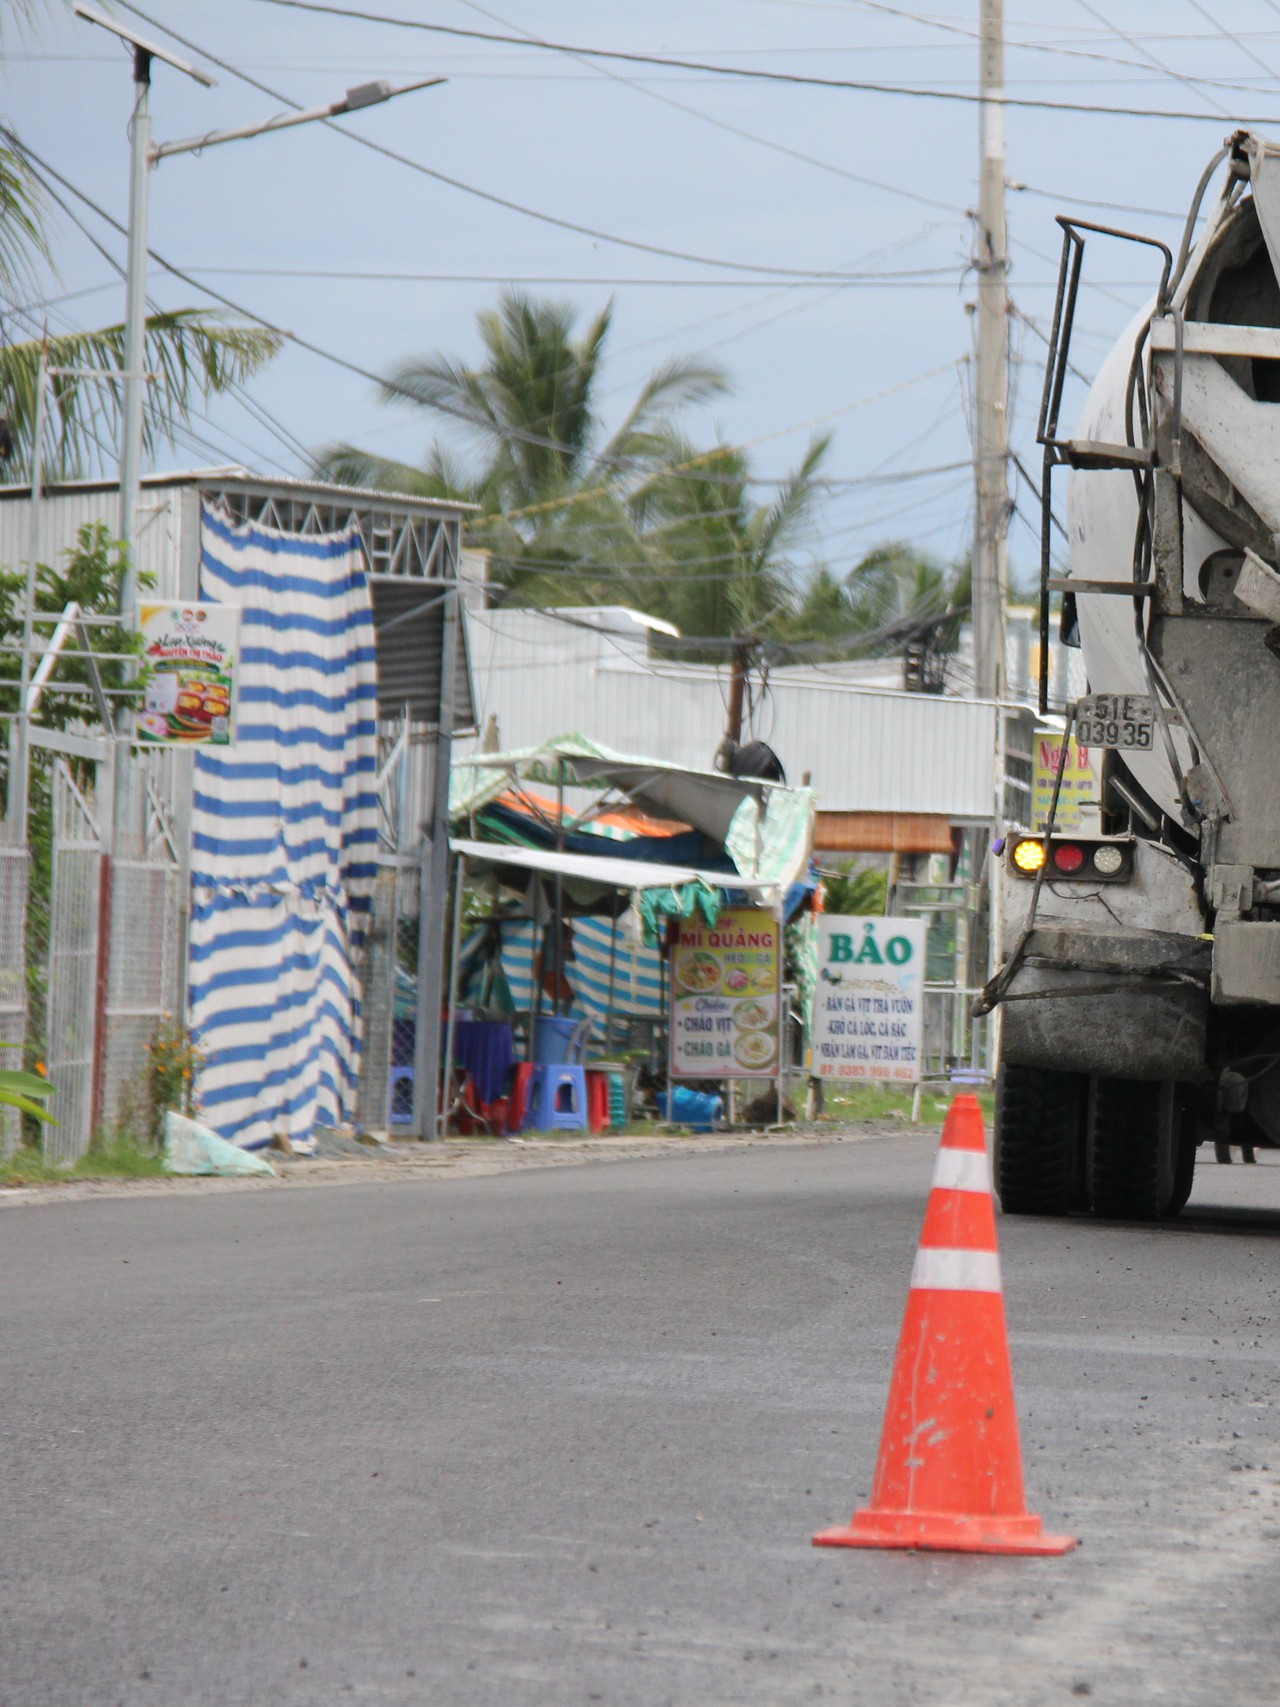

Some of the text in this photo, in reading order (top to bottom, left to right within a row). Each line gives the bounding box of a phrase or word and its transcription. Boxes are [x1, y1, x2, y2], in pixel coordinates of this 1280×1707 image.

[680, 926, 772, 947] MÌ QUẢNG
[828, 922, 913, 965] BẢO
